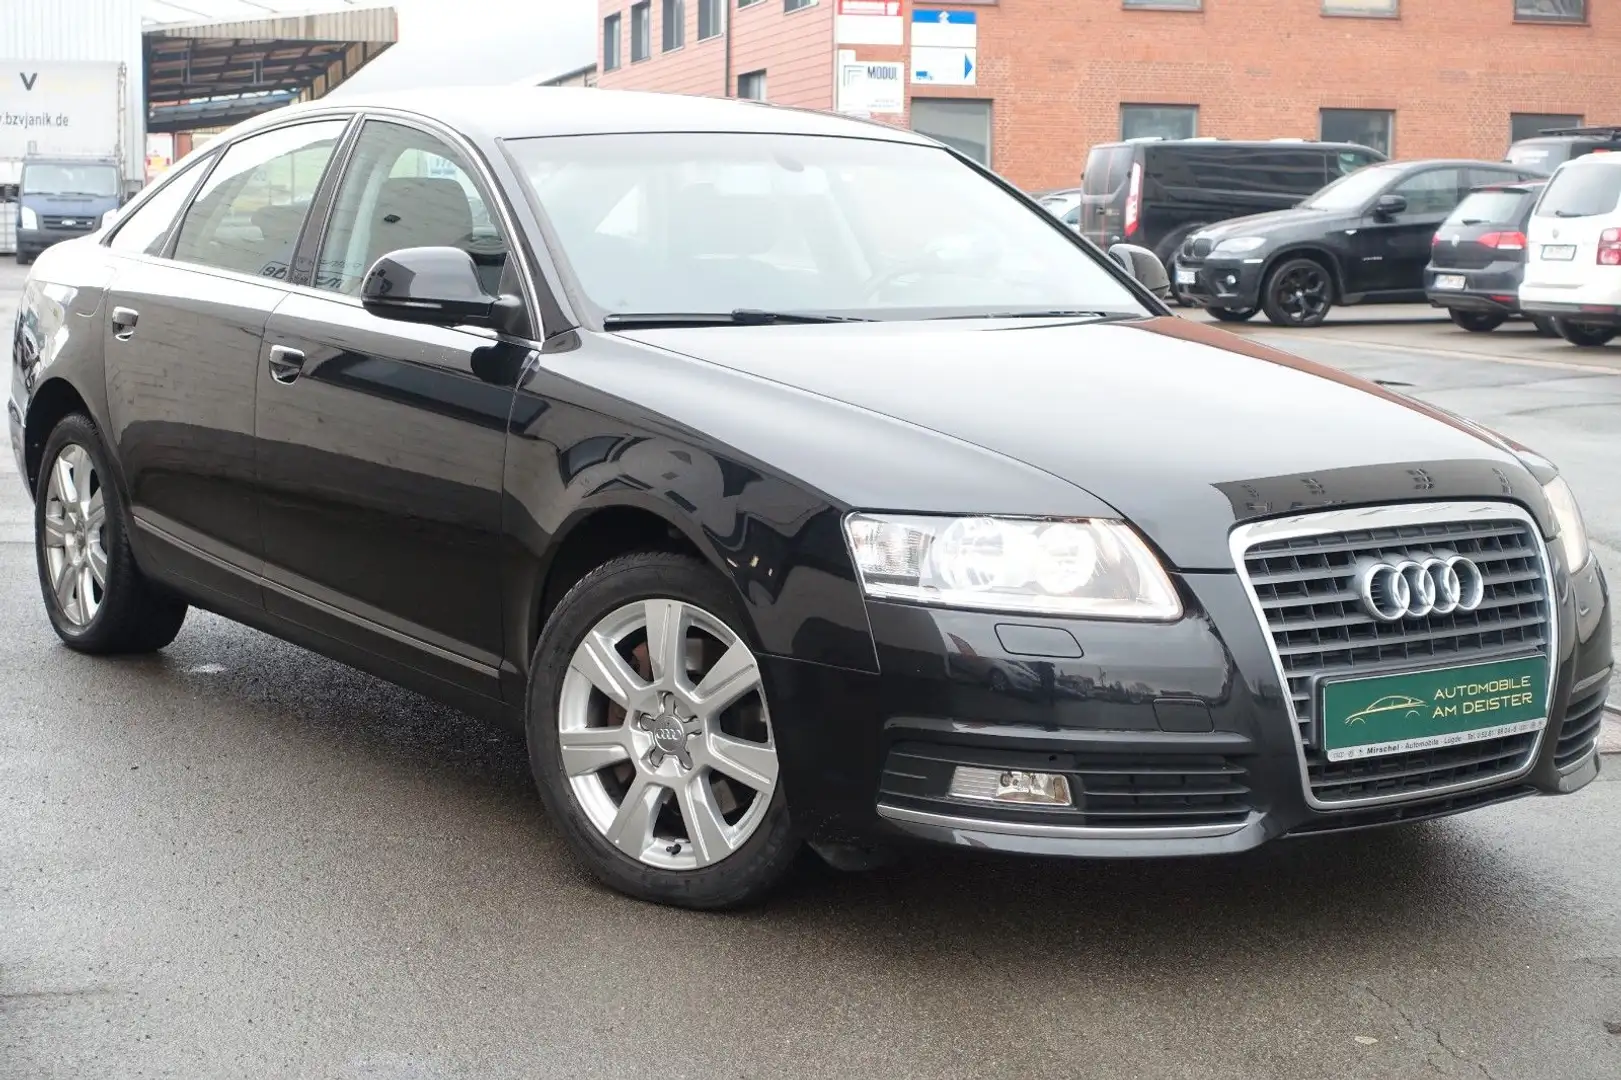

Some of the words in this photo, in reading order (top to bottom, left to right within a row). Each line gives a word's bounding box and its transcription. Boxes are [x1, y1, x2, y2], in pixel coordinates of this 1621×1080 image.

[19, 72, 38, 91] V
[0, 111, 69, 129] .bzvjanik.de
[1434, 675, 1532, 701] AUTOMOBILE
[1432, 704, 1457, 719] AM
[1462, 692, 1533, 715] DEISTER
[1366, 744, 1400, 755] Mirschel
